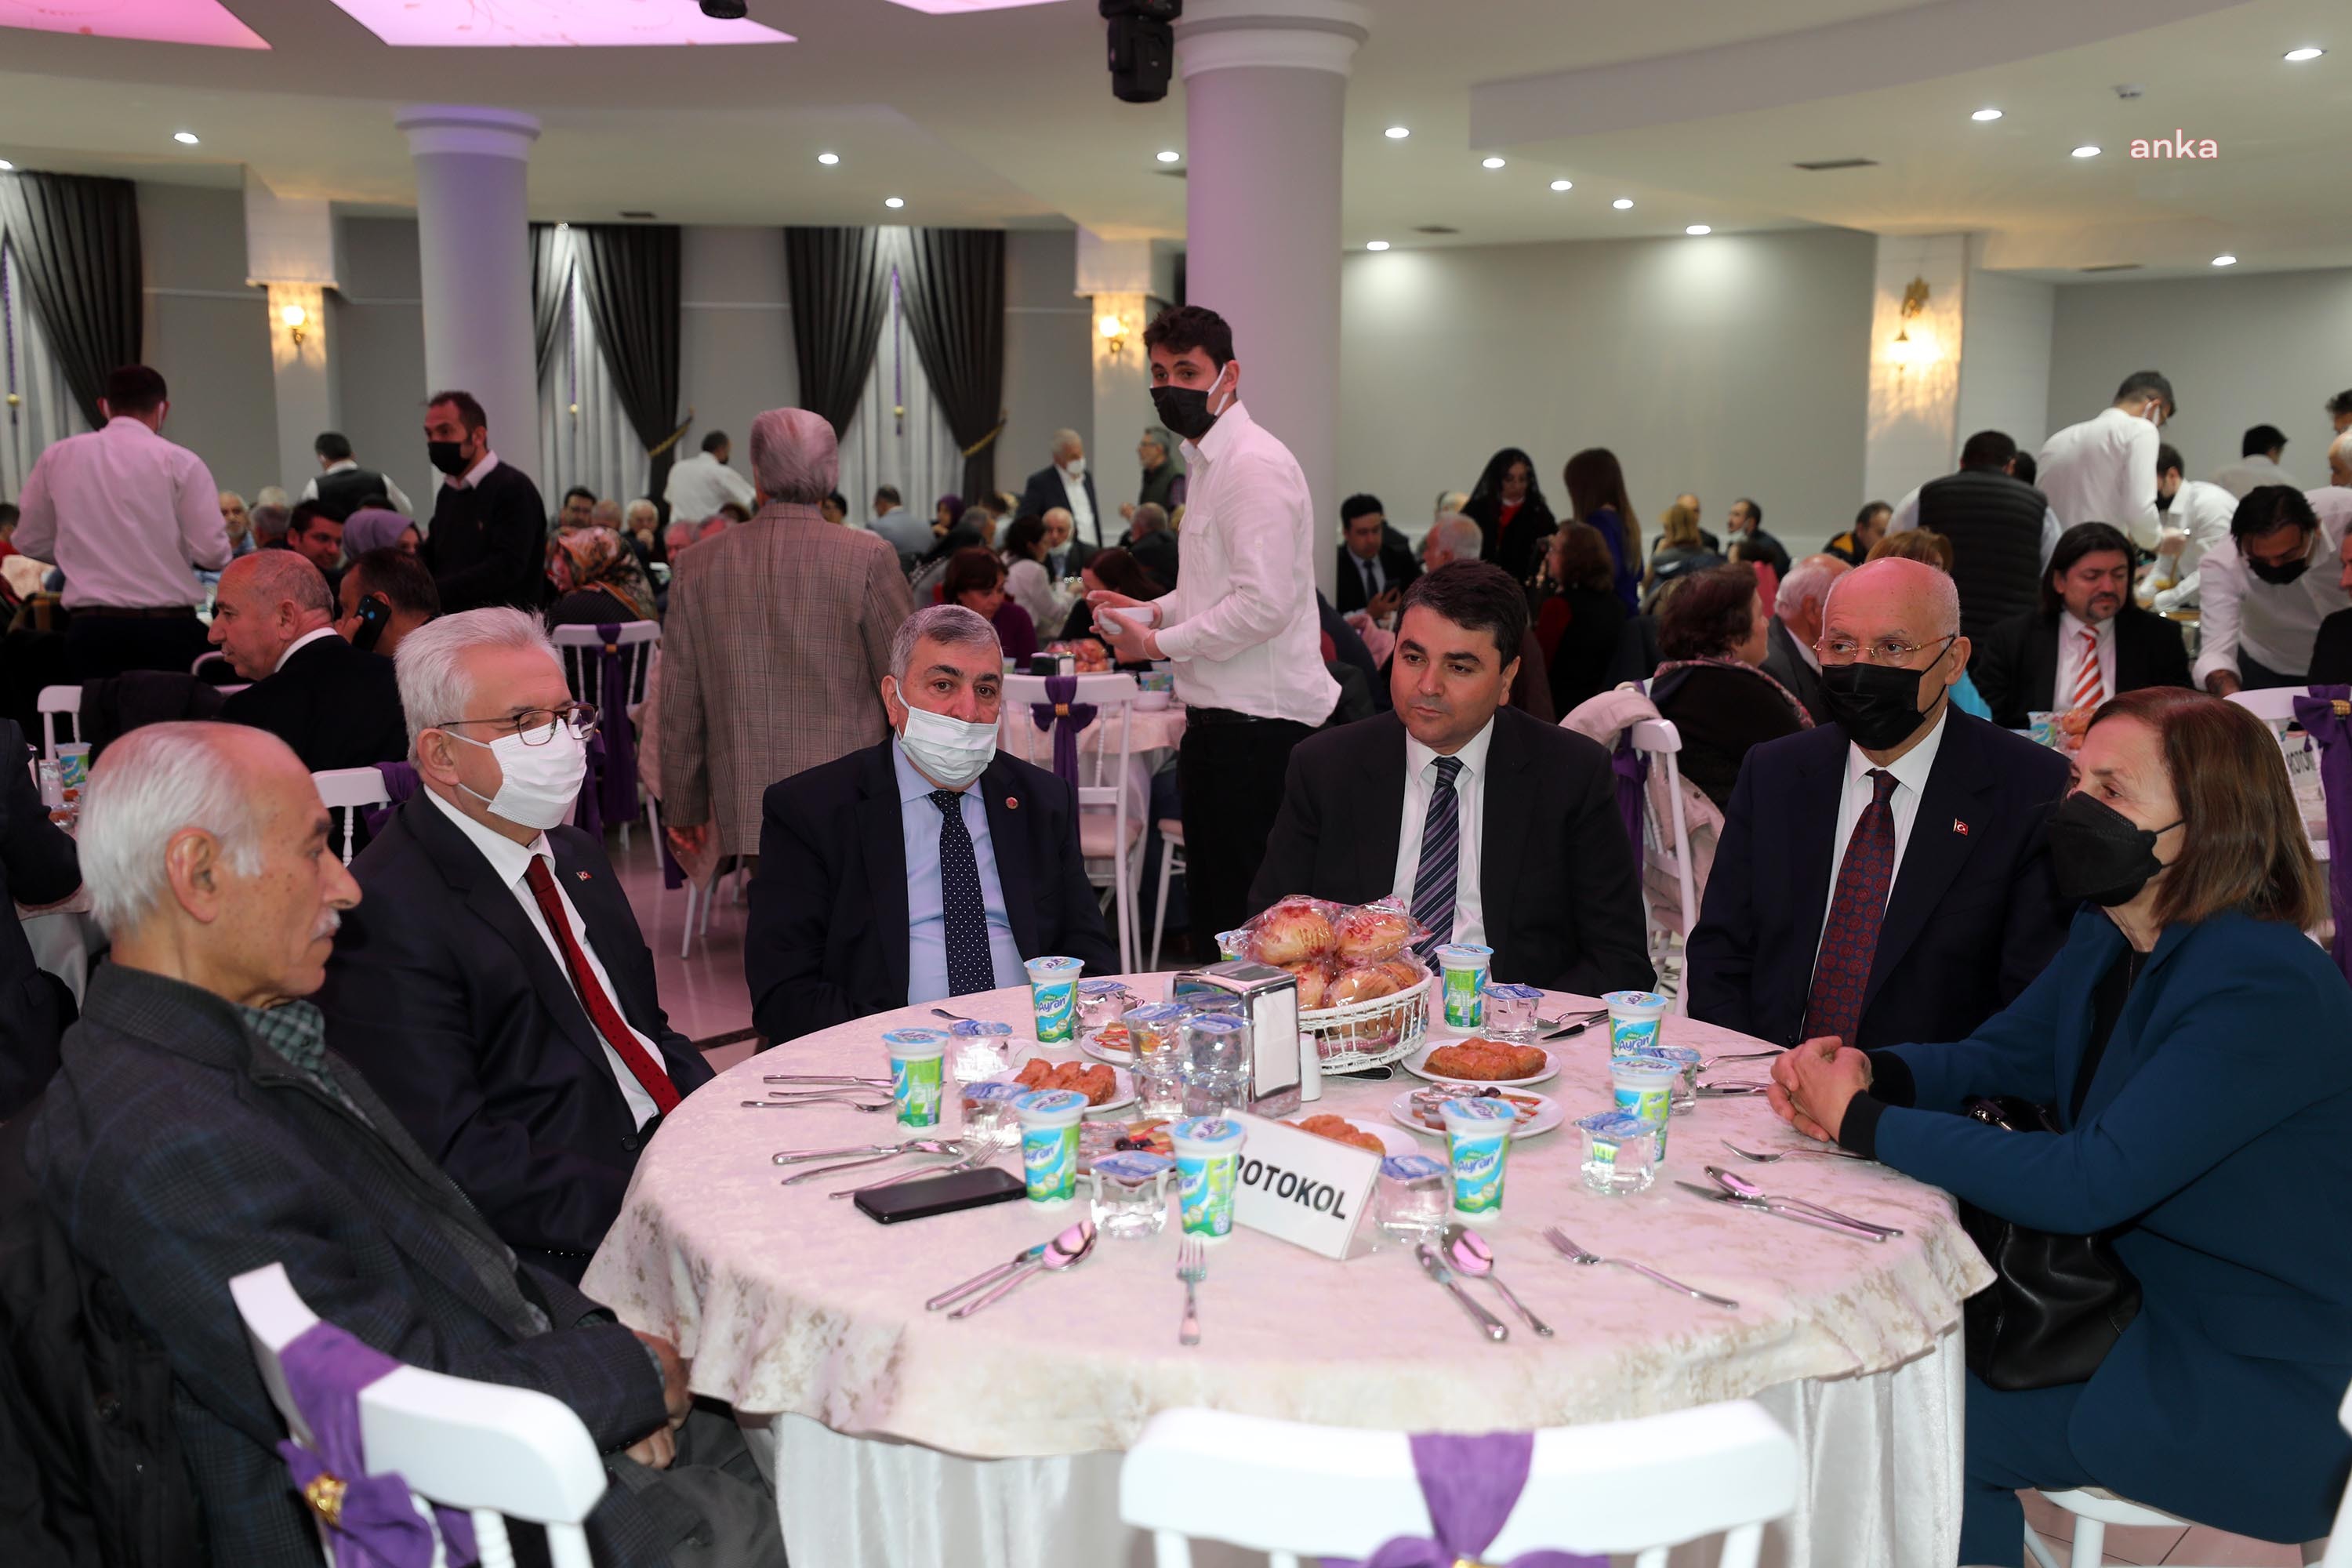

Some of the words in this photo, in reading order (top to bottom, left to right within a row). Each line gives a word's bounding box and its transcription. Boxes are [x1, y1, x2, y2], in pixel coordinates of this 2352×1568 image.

[1038, 995, 1067, 1012] Ayran
[1618, 1036, 1650, 1051] Ayran
[1457, 1156, 1494, 1174] Ayran
[1236, 1152, 1346, 1220] OTOKOL
